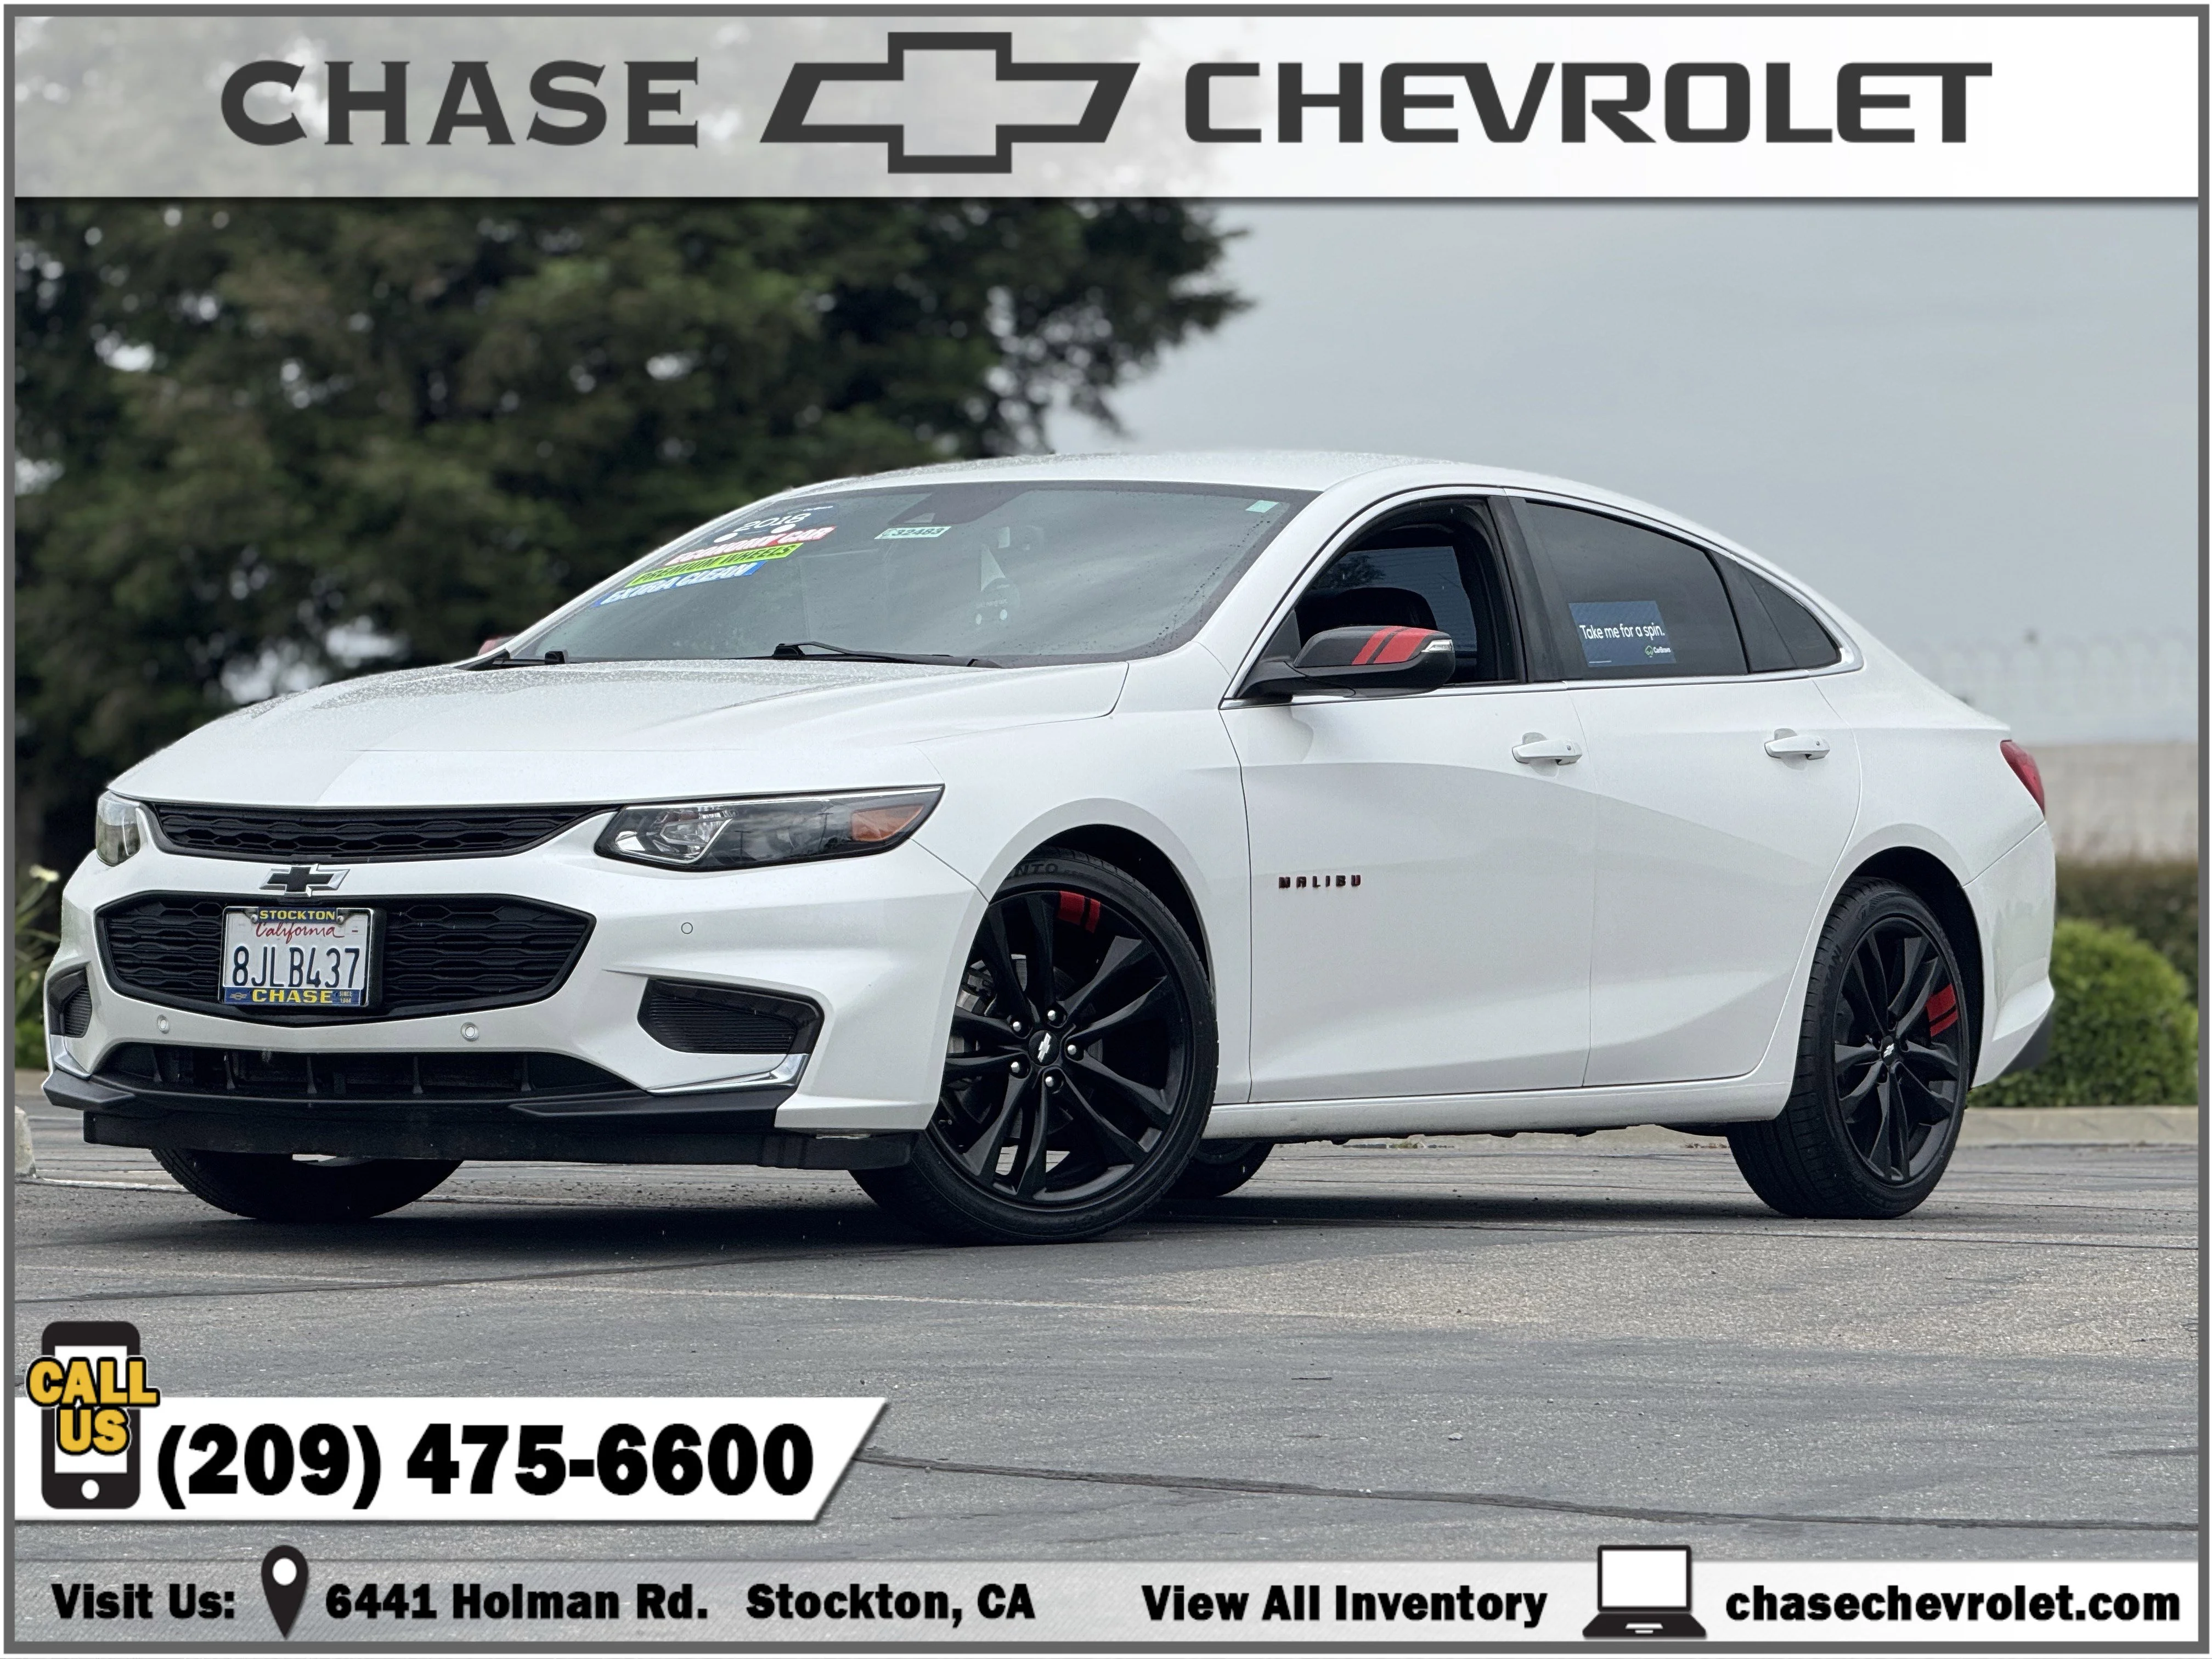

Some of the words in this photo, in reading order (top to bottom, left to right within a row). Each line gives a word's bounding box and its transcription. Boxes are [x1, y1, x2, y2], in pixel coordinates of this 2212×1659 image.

[732, 513, 811, 533] 2018
[664, 533, 787, 566] ECONOMY
[777, 526, 836, 544] CAR
[631, 556, 721, 585] PREMIUM
[717, 544, 798, 566] WHEELS
[600, 576, 681, 605] EXTRA
[675, 562, 759, 587] CLEAN
[1579, 624, 1604, 639] Take
[1604, 627, 1620, 639] me
[1620, 623, 1634, 637] for
[1635, 627, 1643, 637] a
[1643, 622, 1666, 640] spin.
[1278, 874, 1361, 889] MALIBU
[259, 910, 335, 920] STOCKTON
[255, 922, 345, 944] California
[232, 945, 360, 989] 8JLB437
[252, 989, 333, 1003] CHASE
